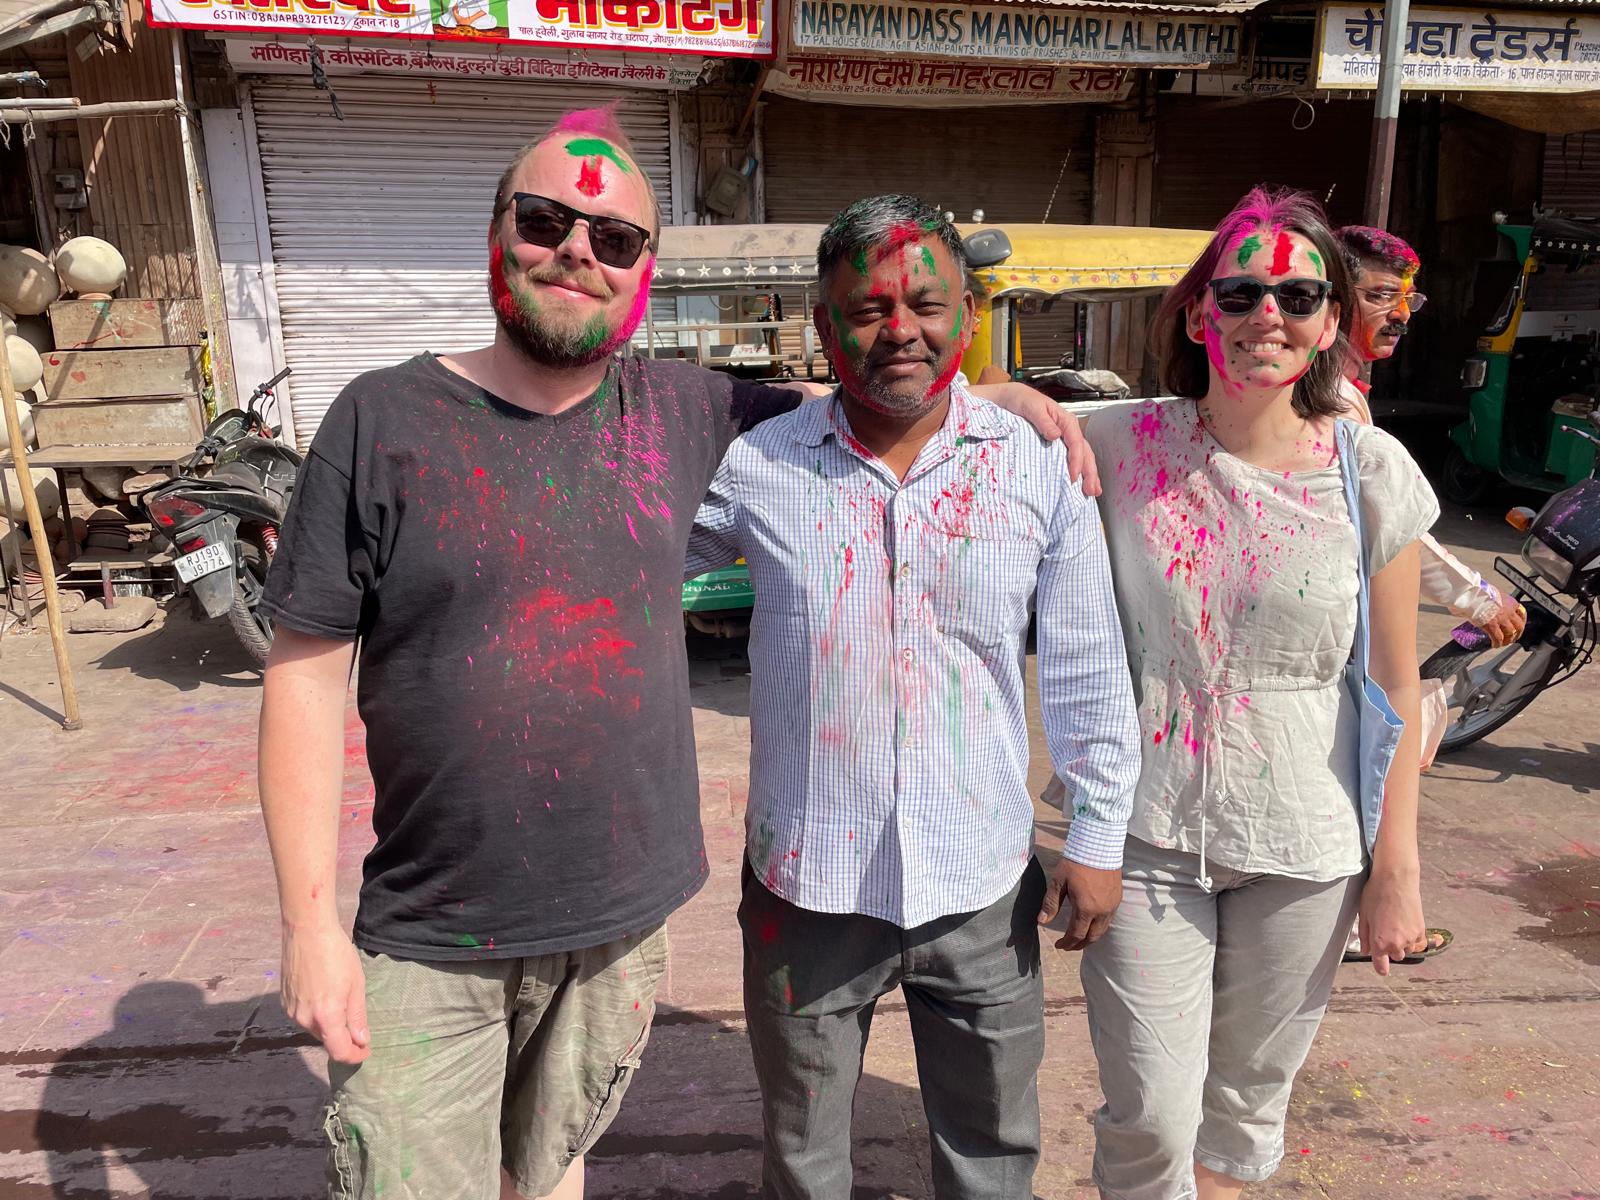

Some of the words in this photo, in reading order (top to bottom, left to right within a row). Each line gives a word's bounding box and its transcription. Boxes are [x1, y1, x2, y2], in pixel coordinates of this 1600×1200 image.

[390, 19, 400, 28] 18
[801, 1, 902, 39] NARAYAN
[907, 7, 963, 43] DASS
[1156, 22, 1237, 53] RATHI
[813, 36, 830, 46] PAL
[833, 37, 859, 47] HOUSE
[977, 45, 992, 55] ALL
[994, 46, 1019, 57] KINDS
[1021, 48, 1031, 56] OF
[1033, 48, 1068, 58] BRUSHES
[1071, 51, 1079, 59] &
[1469, 14, 1580, 64] ट्रेडर्स
[655, 64, 668, 80] के
